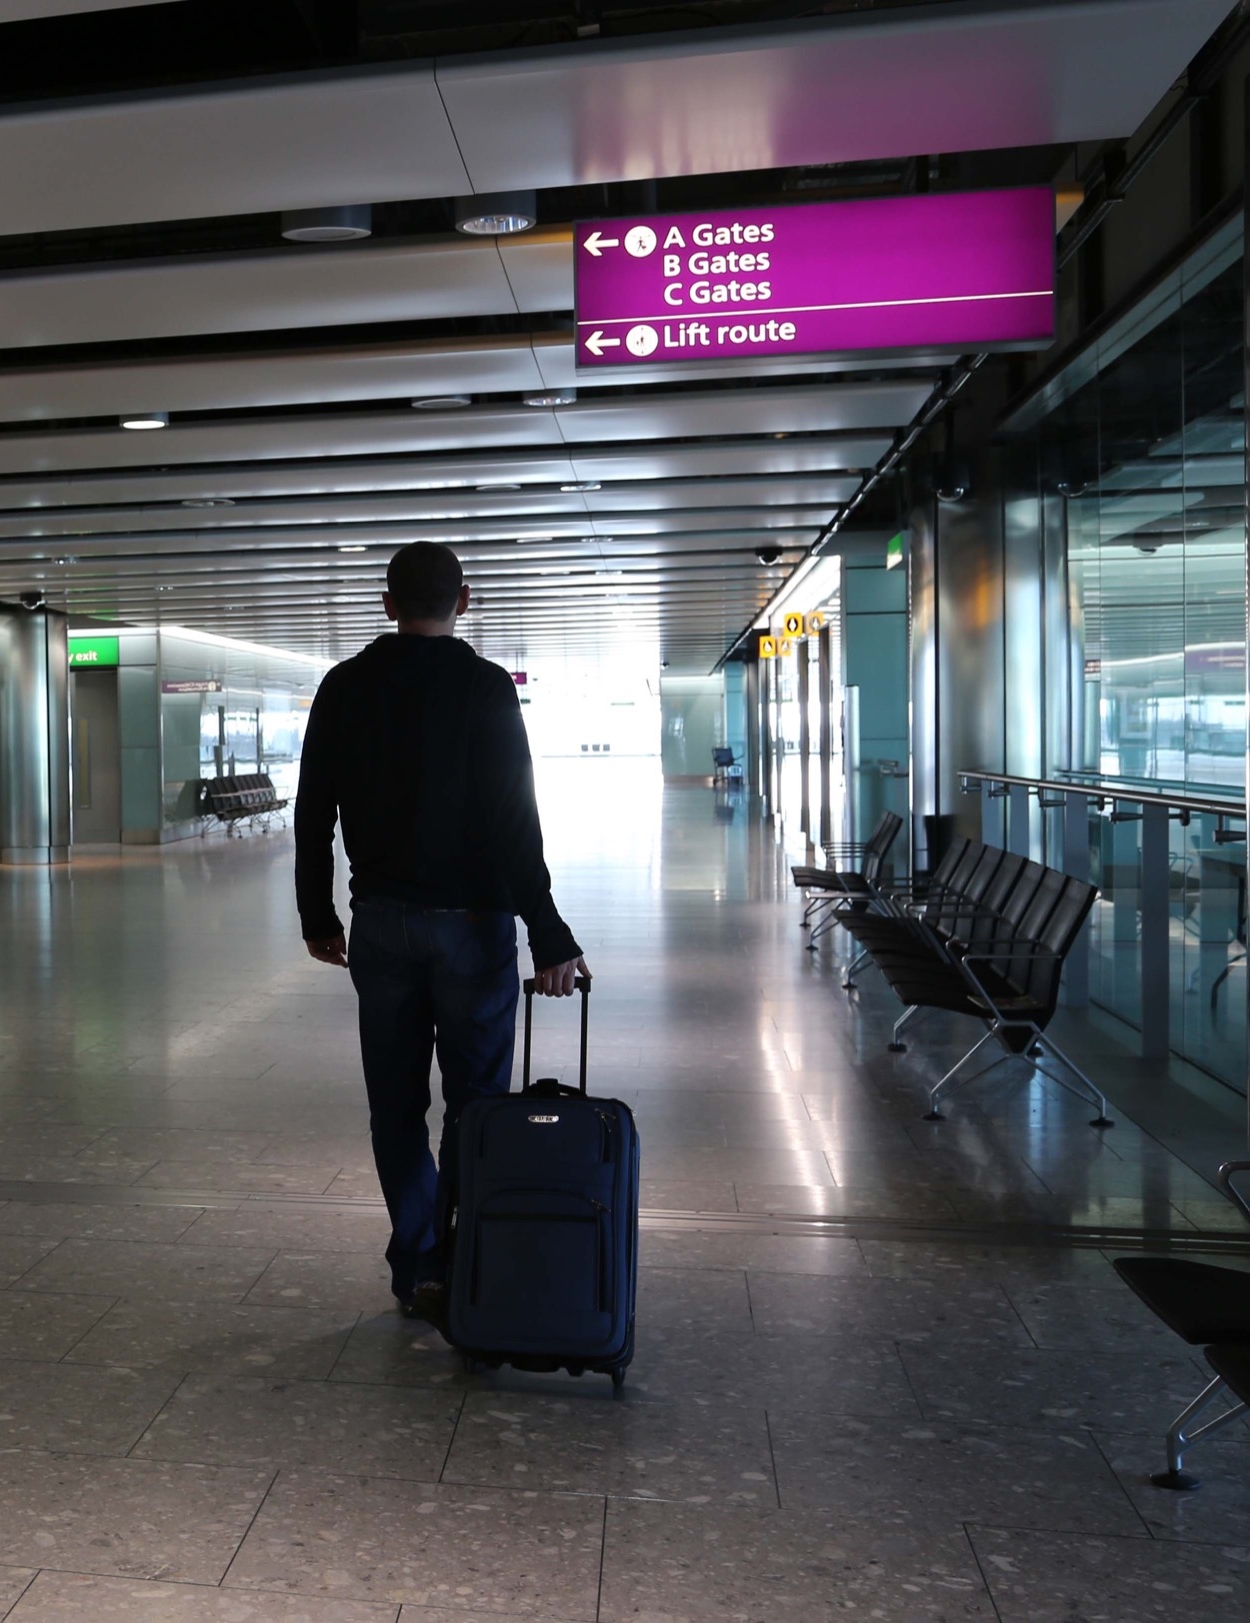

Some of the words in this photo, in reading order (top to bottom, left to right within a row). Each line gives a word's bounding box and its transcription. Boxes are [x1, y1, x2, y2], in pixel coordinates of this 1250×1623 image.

[663, 226, 686, 249] A
[692, 222, 775, 247] Gates
[663, 254, 681, 277] B
[688, 250, 770, 275] Gates
[663, 282, 683, 306] C
[689, 280, 772, 304] Gates
[664, 322, 711, 348] Lift
[717, 319, 796, 345] route
[75, 650, 98, 662] exit
